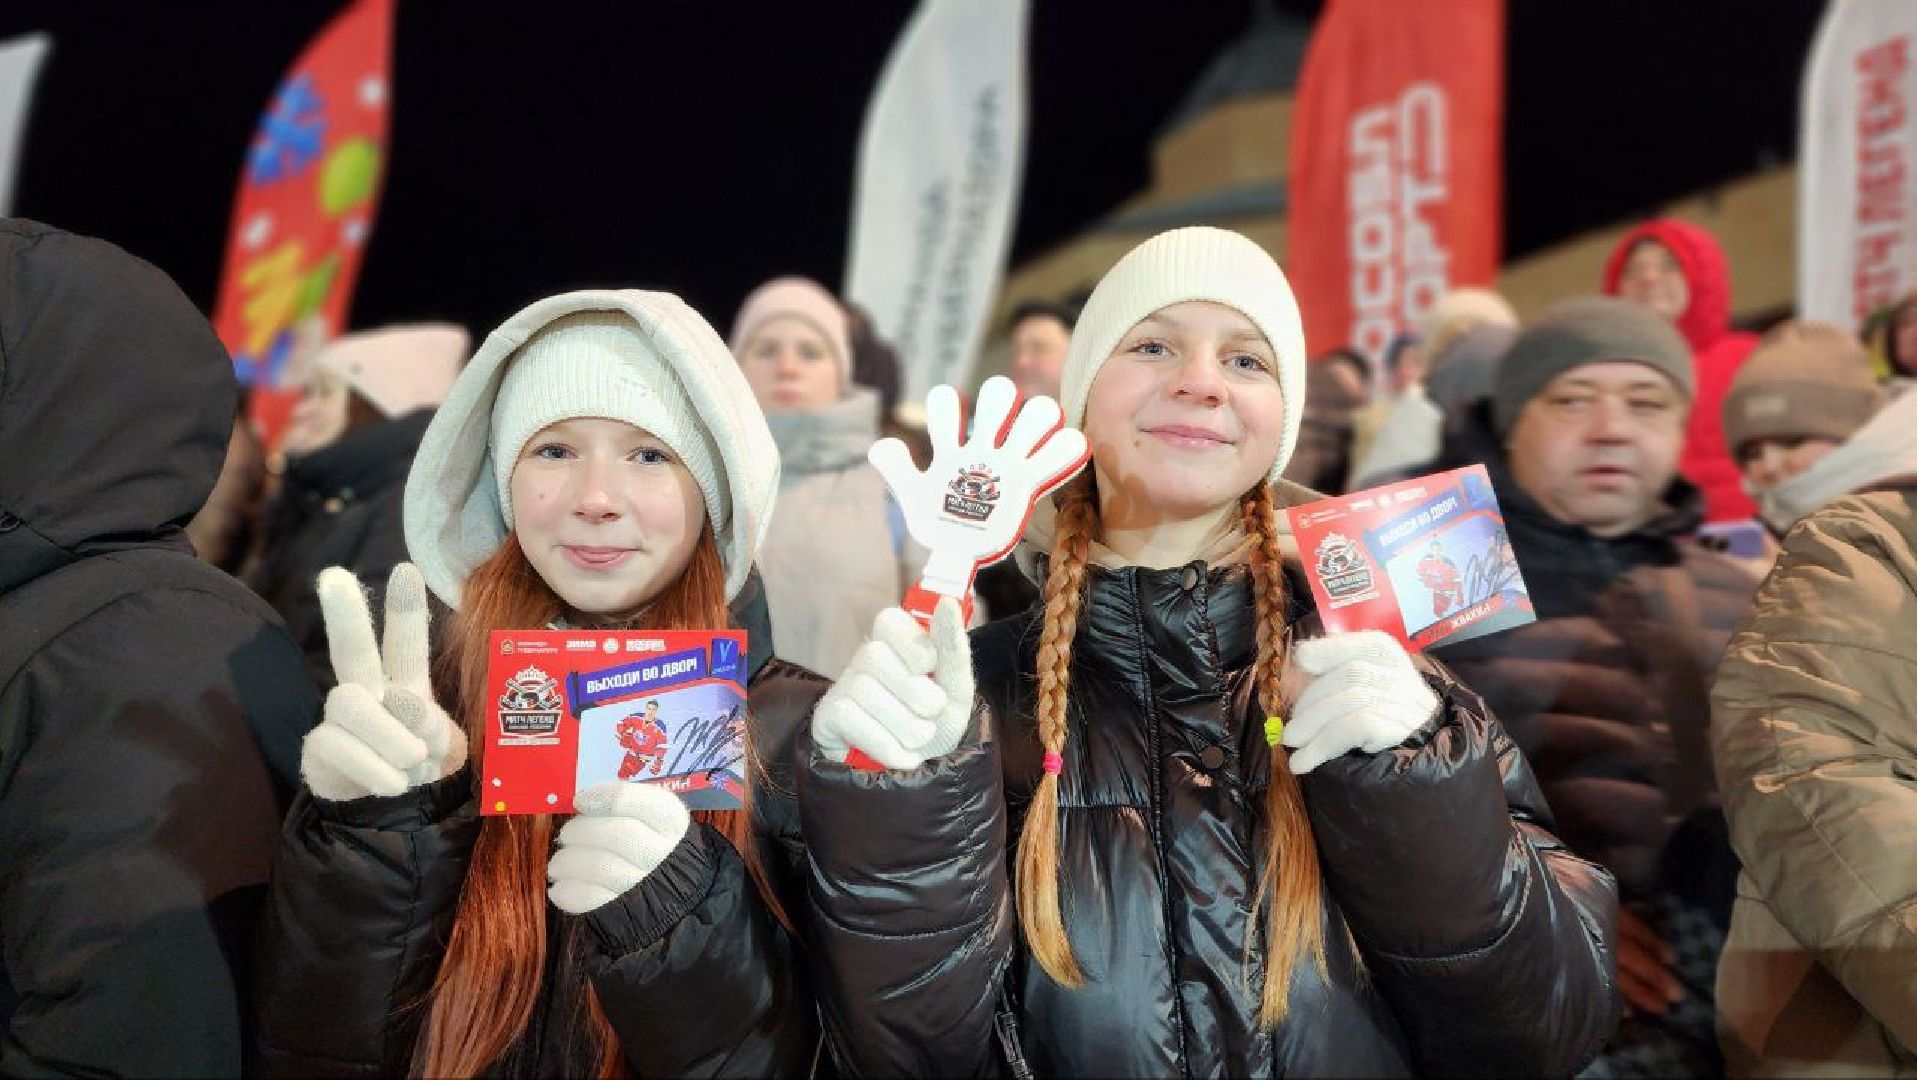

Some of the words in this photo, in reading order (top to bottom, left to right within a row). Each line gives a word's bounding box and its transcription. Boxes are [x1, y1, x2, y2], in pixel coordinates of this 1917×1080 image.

[1347, 103, 1398, 358] ОСОБЛ
[1853, 232, 1902, 323] АТЧ
[586, 670, 640, 694] ВЫХОДИ
[642, 667, 659, 682] ВО
[660, 656, 698, 678] ДВОР!
